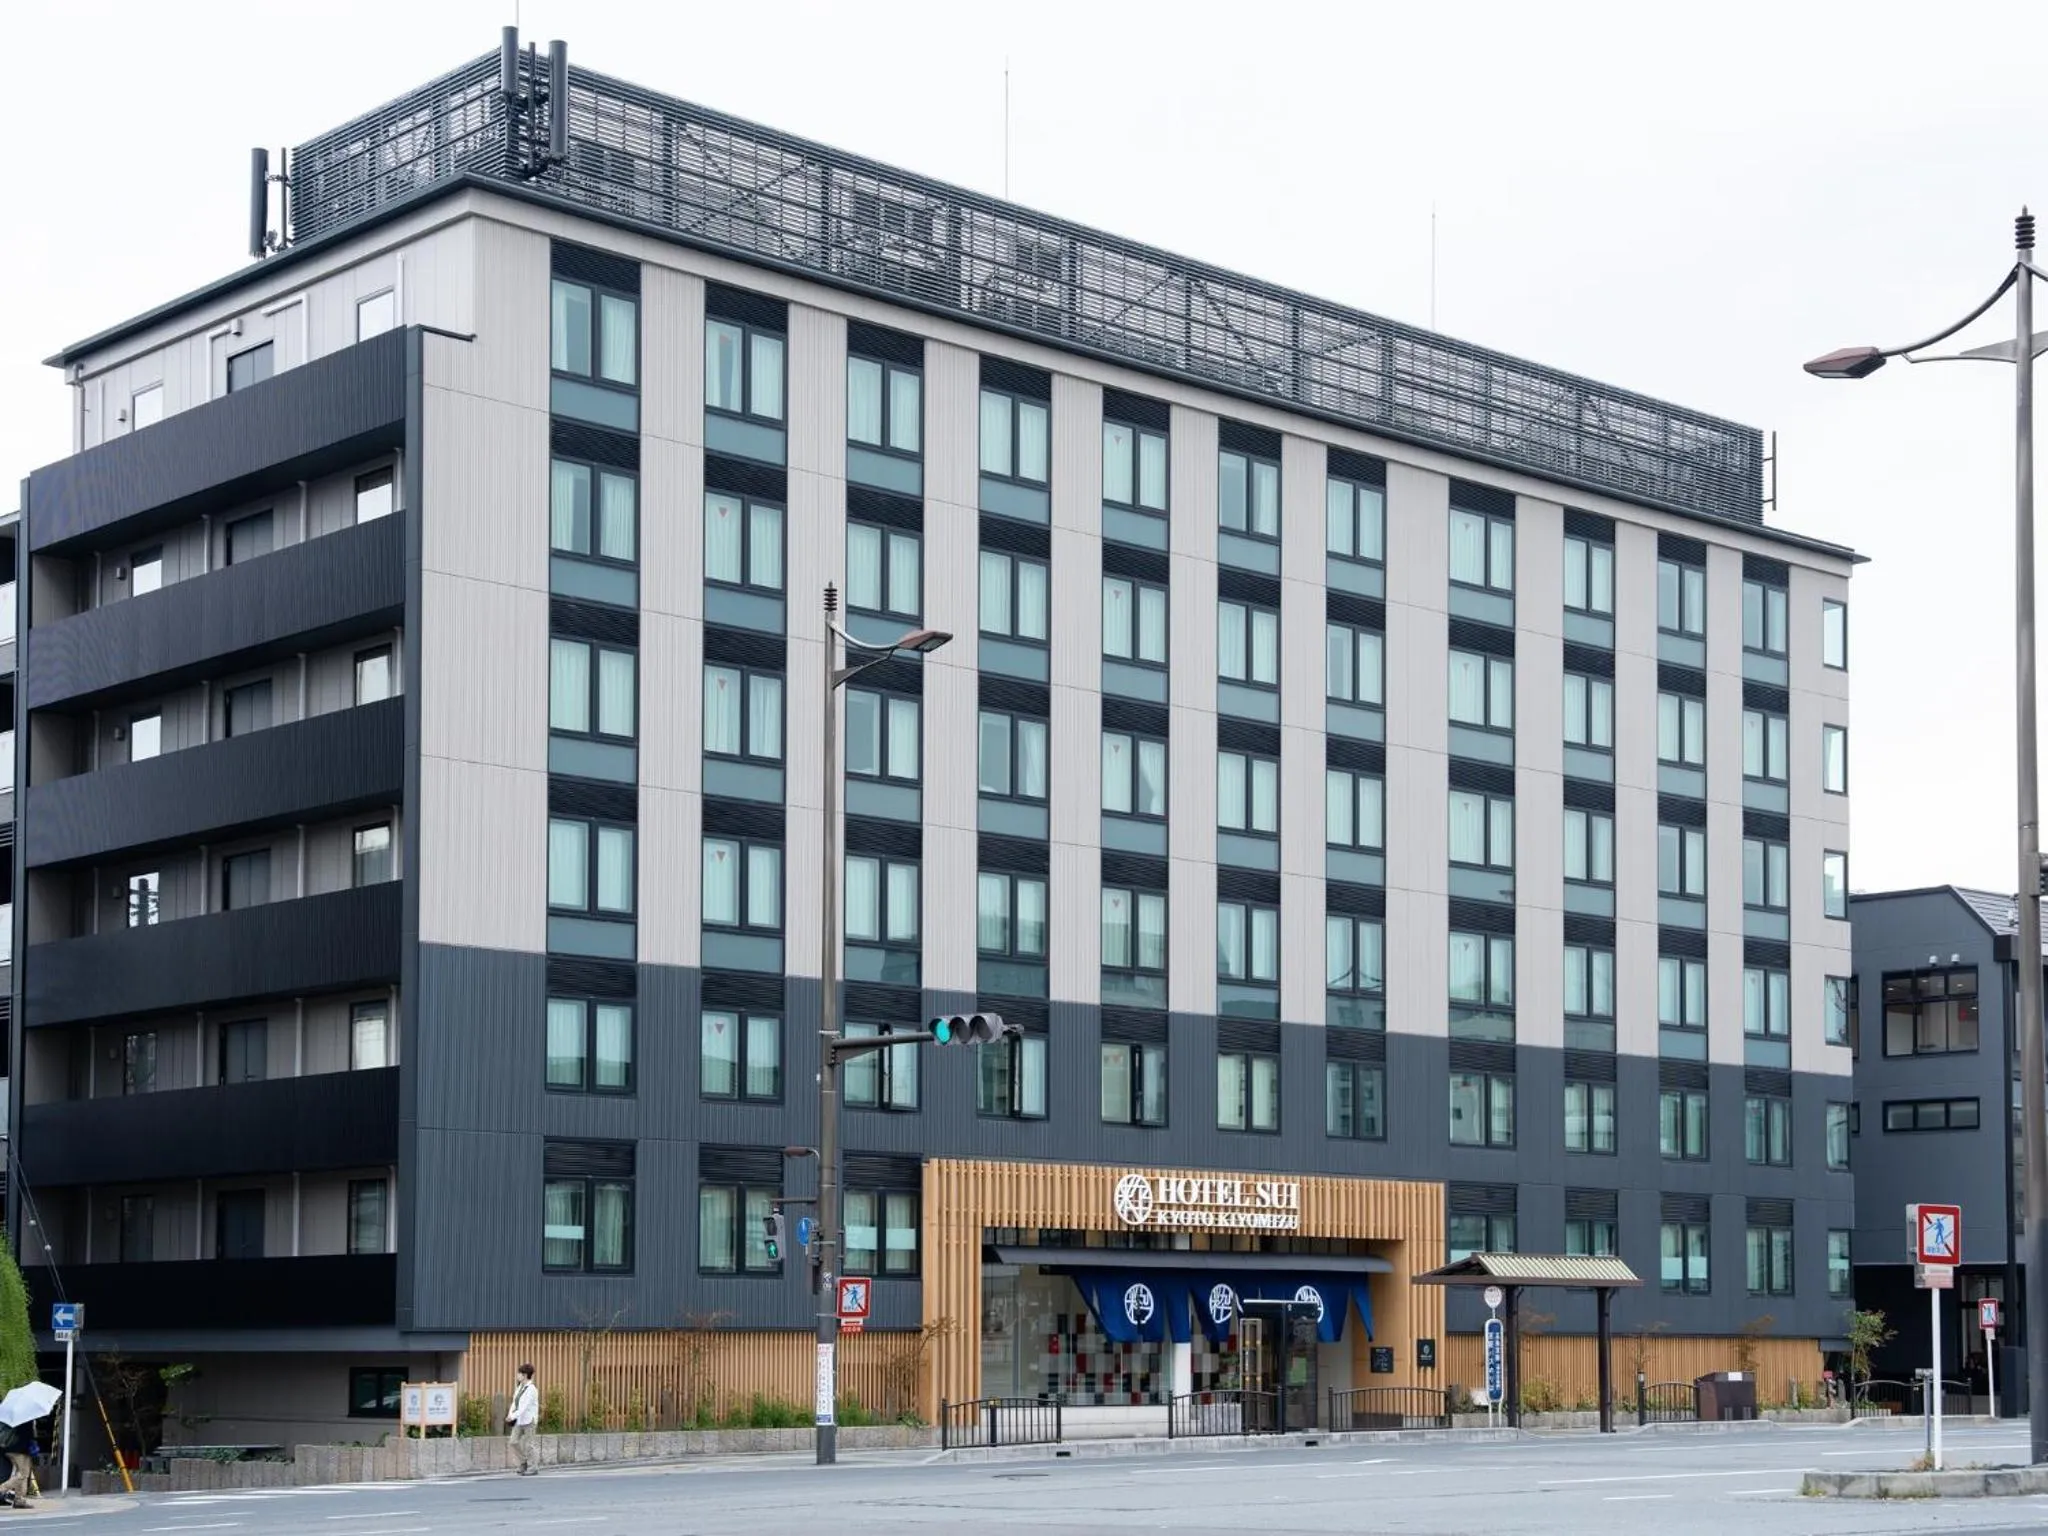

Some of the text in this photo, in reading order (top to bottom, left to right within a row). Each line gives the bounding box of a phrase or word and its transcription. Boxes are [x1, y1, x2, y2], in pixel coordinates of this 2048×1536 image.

[1158, 1178, 1249, 1206] HOTEL
[1255, 1182, 1300, 1209] SUI
[1157, 1210, 1299, 1230] KYOTO KIYOMIZU
